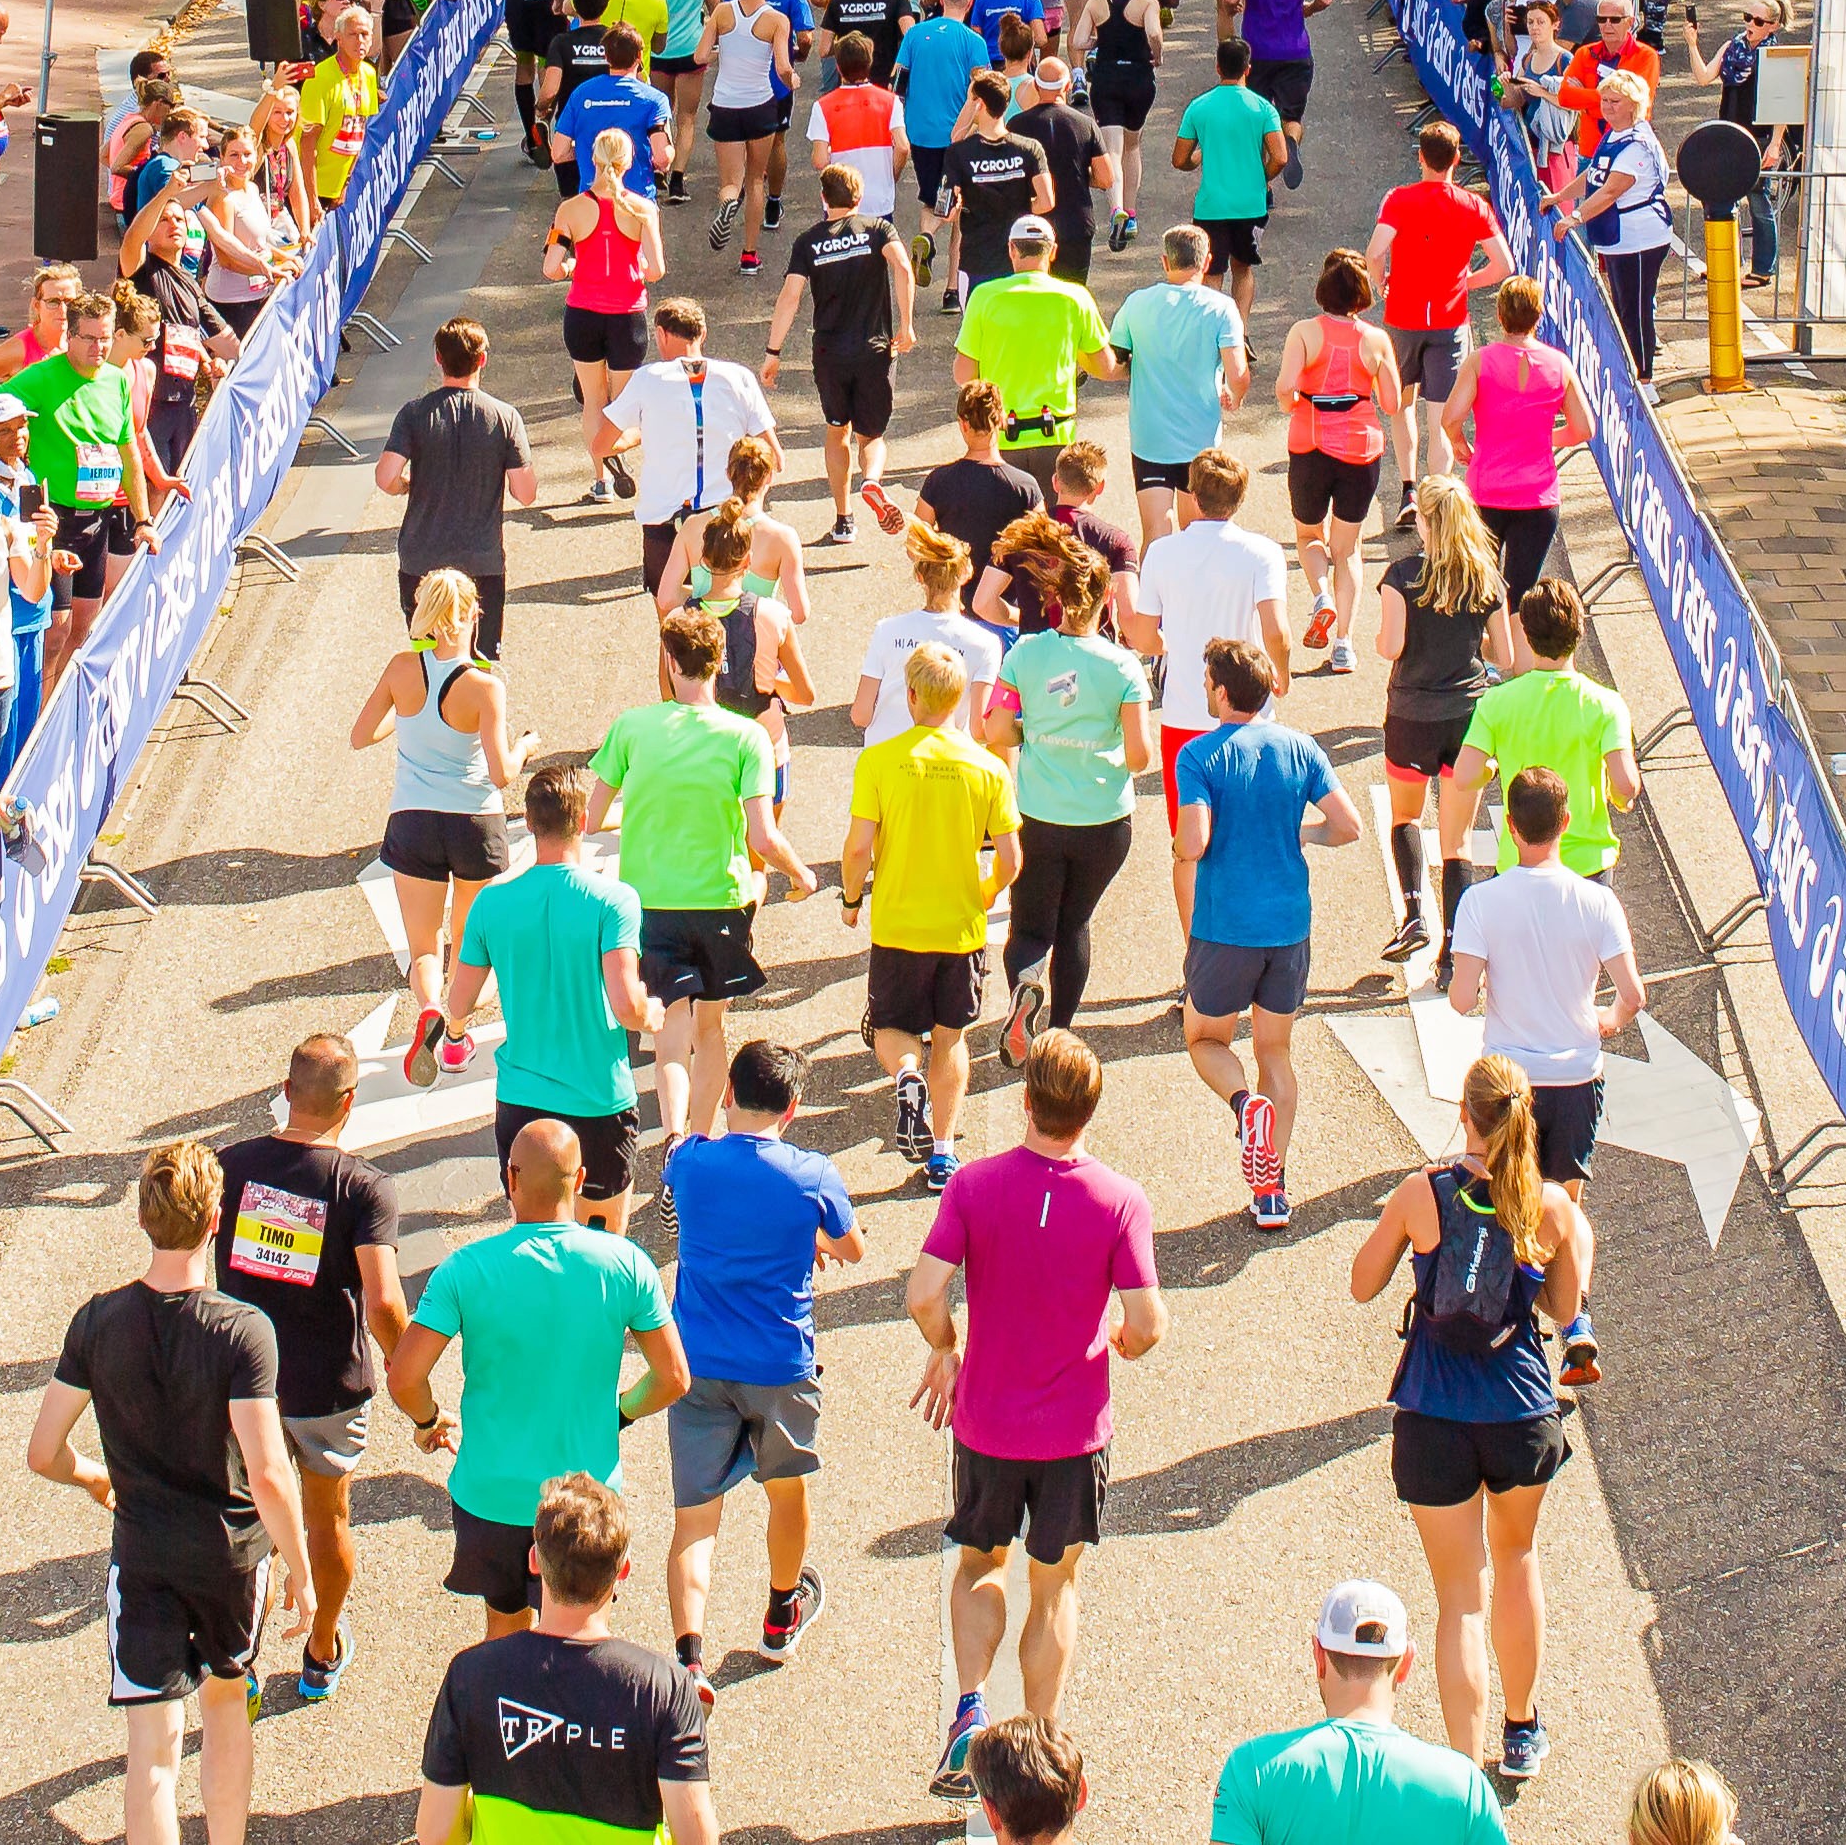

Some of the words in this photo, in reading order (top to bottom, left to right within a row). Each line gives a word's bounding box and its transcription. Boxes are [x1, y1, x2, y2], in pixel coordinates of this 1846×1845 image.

[840, 1, 887, 14] YGROUP
[573, 44, 606, 56] YGRO
[969, 156, 1024, 173] YGROUP
[811, 233, 870, 255] YGROUP
[259, 1224, 295, 1248] TIMO
[256, 1247, 291, 1266] 34142
[500, 1716, 628, 1751] TRIPLE
